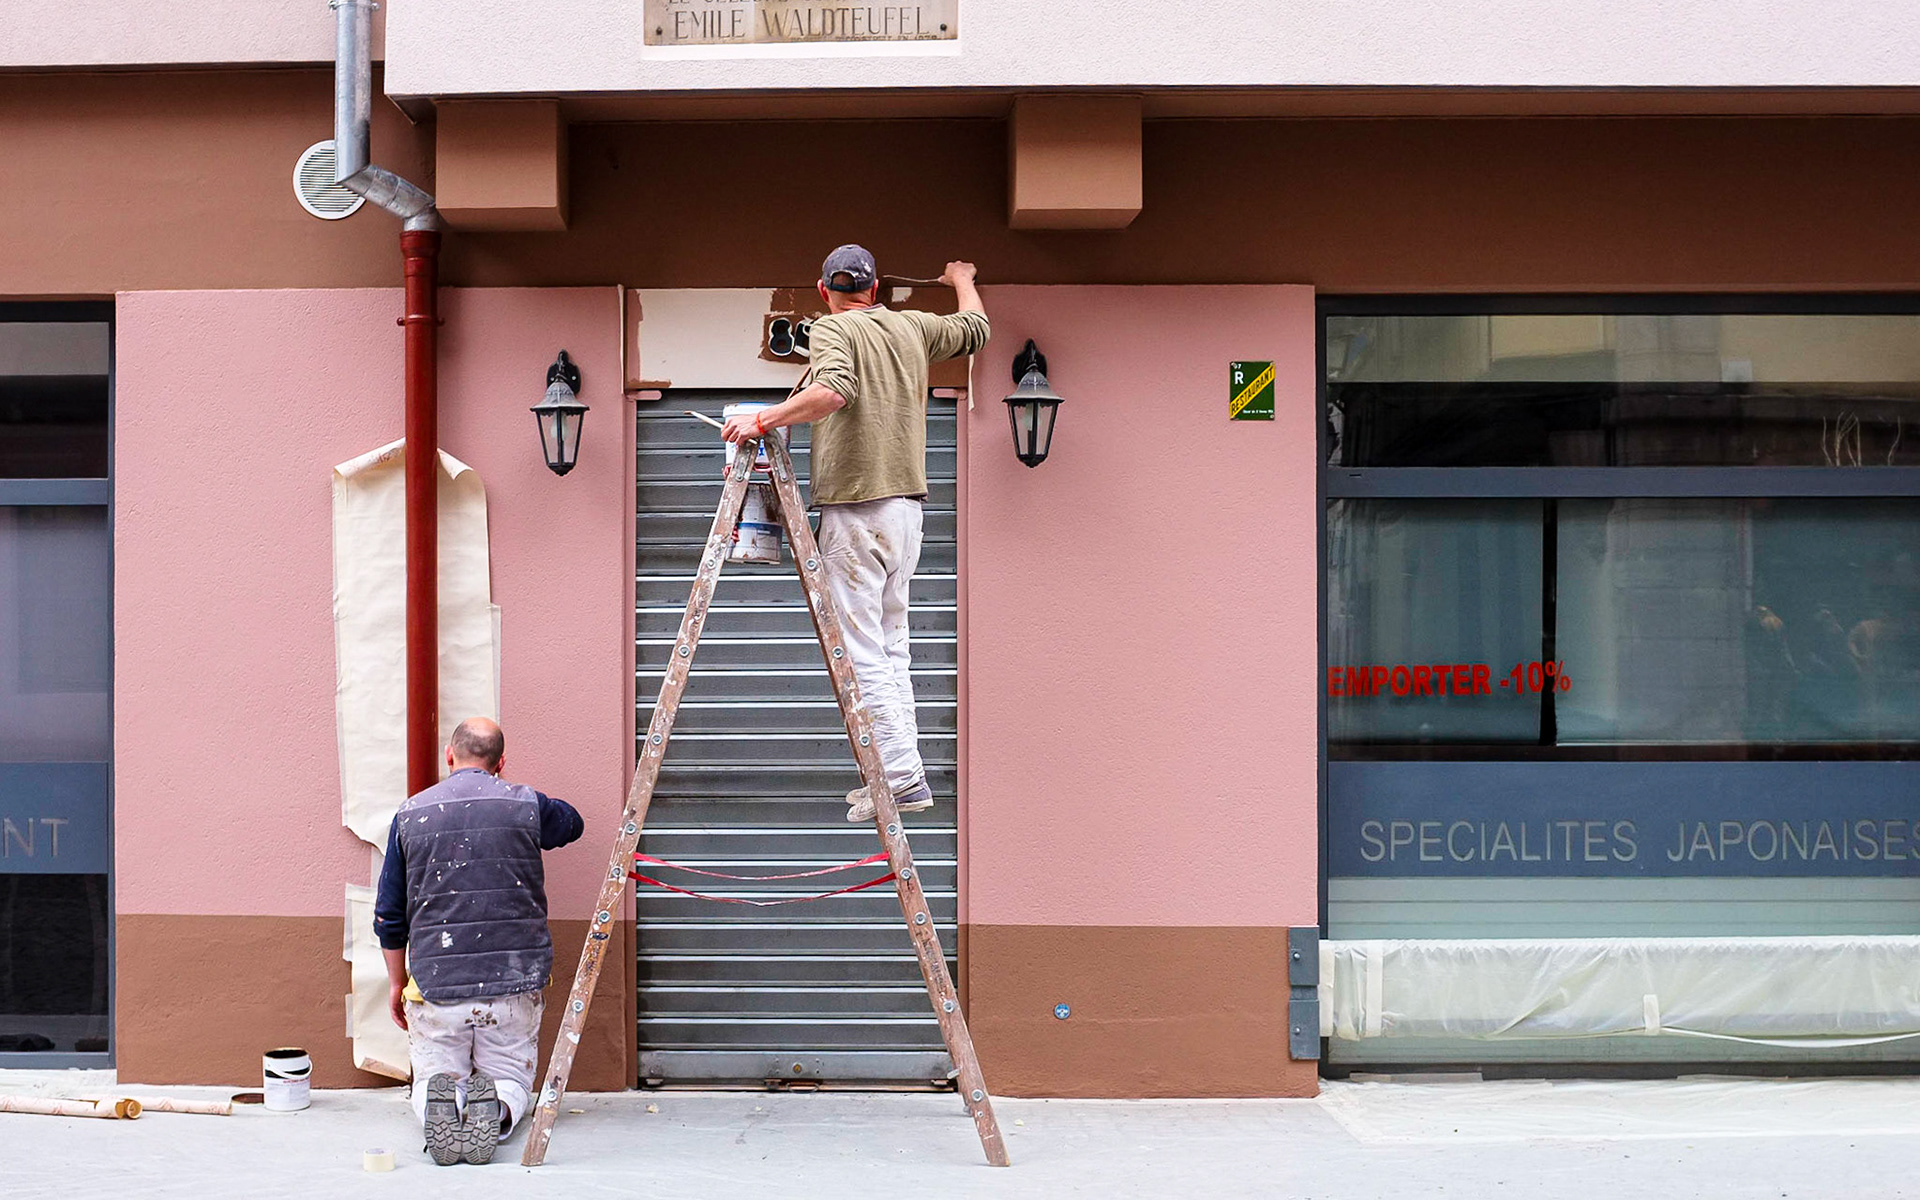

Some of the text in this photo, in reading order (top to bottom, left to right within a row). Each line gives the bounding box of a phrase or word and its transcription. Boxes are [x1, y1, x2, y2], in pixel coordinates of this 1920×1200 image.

[675, 7, 930, 40] EMILE WALDTEUFEL
[1234, 371, 1244, 385] R
[1328, 660, 1572, 697] EMPORTER -10%
[1360, 820, 1638, 862] SPECIALITES
